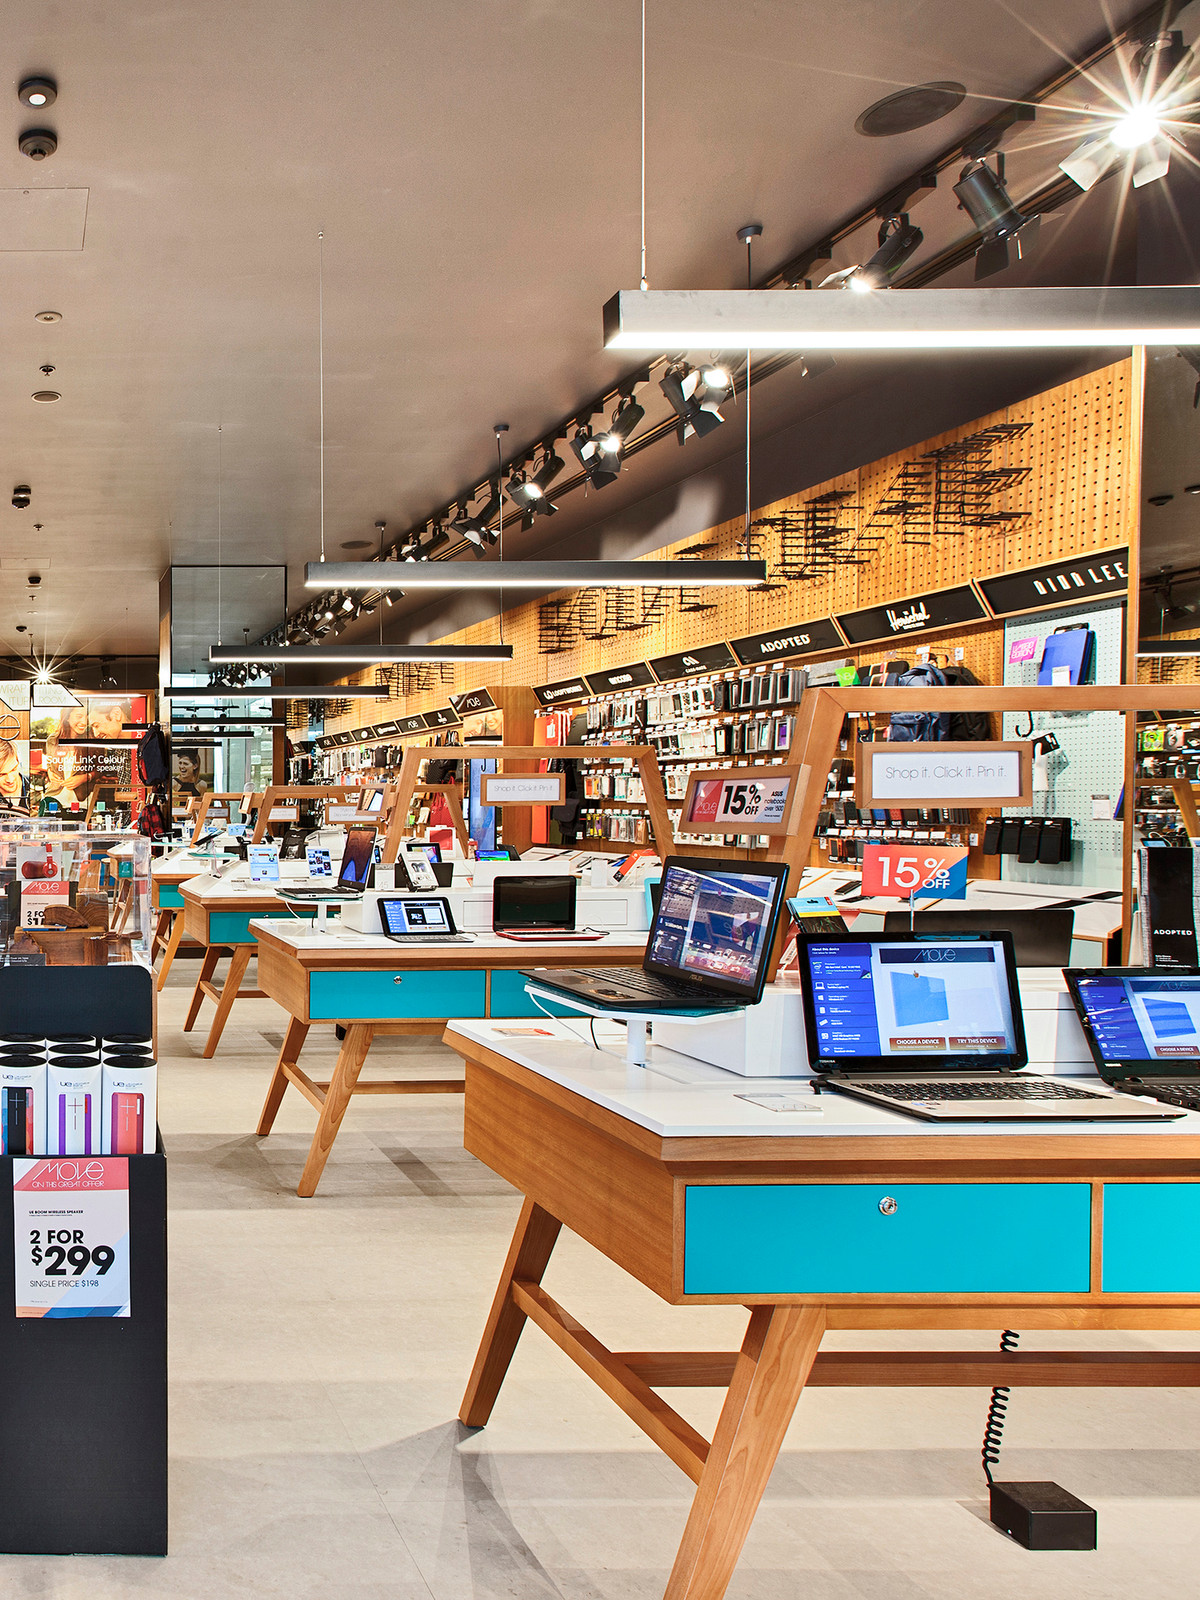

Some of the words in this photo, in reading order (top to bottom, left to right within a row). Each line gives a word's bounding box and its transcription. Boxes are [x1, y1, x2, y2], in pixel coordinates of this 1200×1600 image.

[1087, 562, 1128, 584] LEE
[760, 633, 811, 654] ADOPTED
[38, 696, 67, 704] ROOM
[885, 766, 919, 781] Shop
[921, 766, 931, 778] it.
[933, 765, 963, 778] Click
[965, 766, 975, 778] it.
[977, 765, 995, 777] Pin
[997, 765, 1007, 777] it.
[722, 784, 762, 815] 15%
[744, 805, 759, 815] OFF
[878, 856, 951, 888] 15%
[922, 878, 951, 889] OFF
[29, 1229, 41, 1244] 2
[47, 1229, 84, 1244] FOR
[31, 1245, 115, 1275] $299
[29, 1280, 56, 1288] SINGLE
